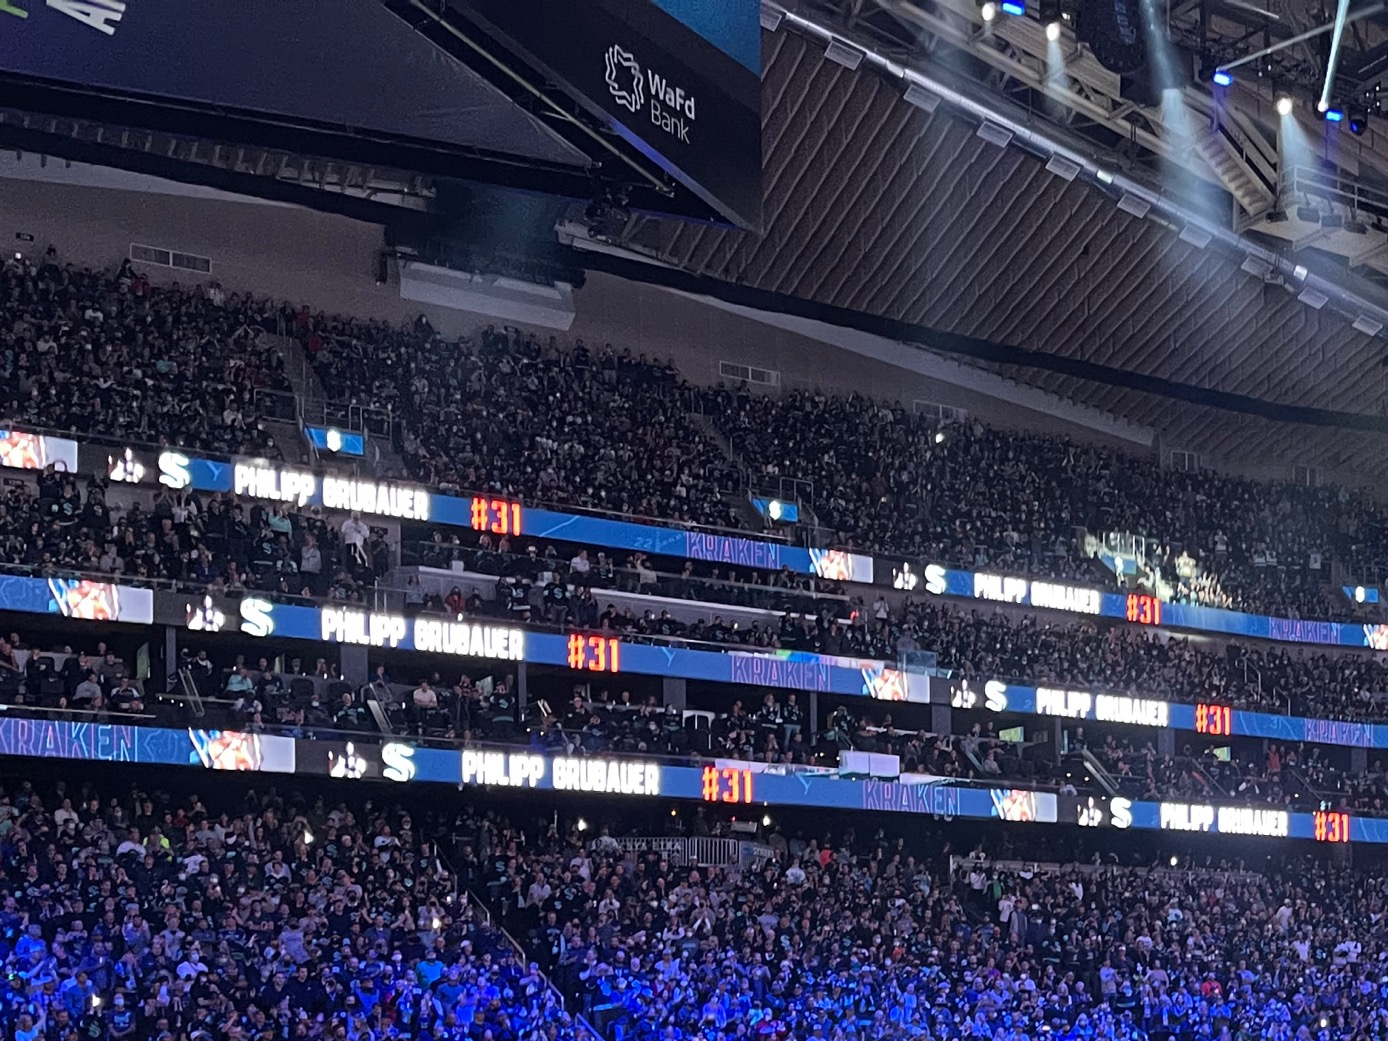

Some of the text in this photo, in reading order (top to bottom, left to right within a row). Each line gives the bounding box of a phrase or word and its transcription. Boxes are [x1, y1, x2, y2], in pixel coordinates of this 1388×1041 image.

[647, 68, 696, 120] WaFd
[651, 99, 690, 144] Bank
[322, 476, 430, 520] GRUBAUER
[471, 497, 522, 536] #31
[1126, 594, 1161, 625] #31
[414, 620, 524, 661] GRUBAUER
[568, 633, 620, 673] #31
[1195, 704, 1231, 736] #31
[552, 756, 660, 796] GRUBAUER
[703, 766, 753, 803] #31
[1314, 812, 1350, 843] #31
